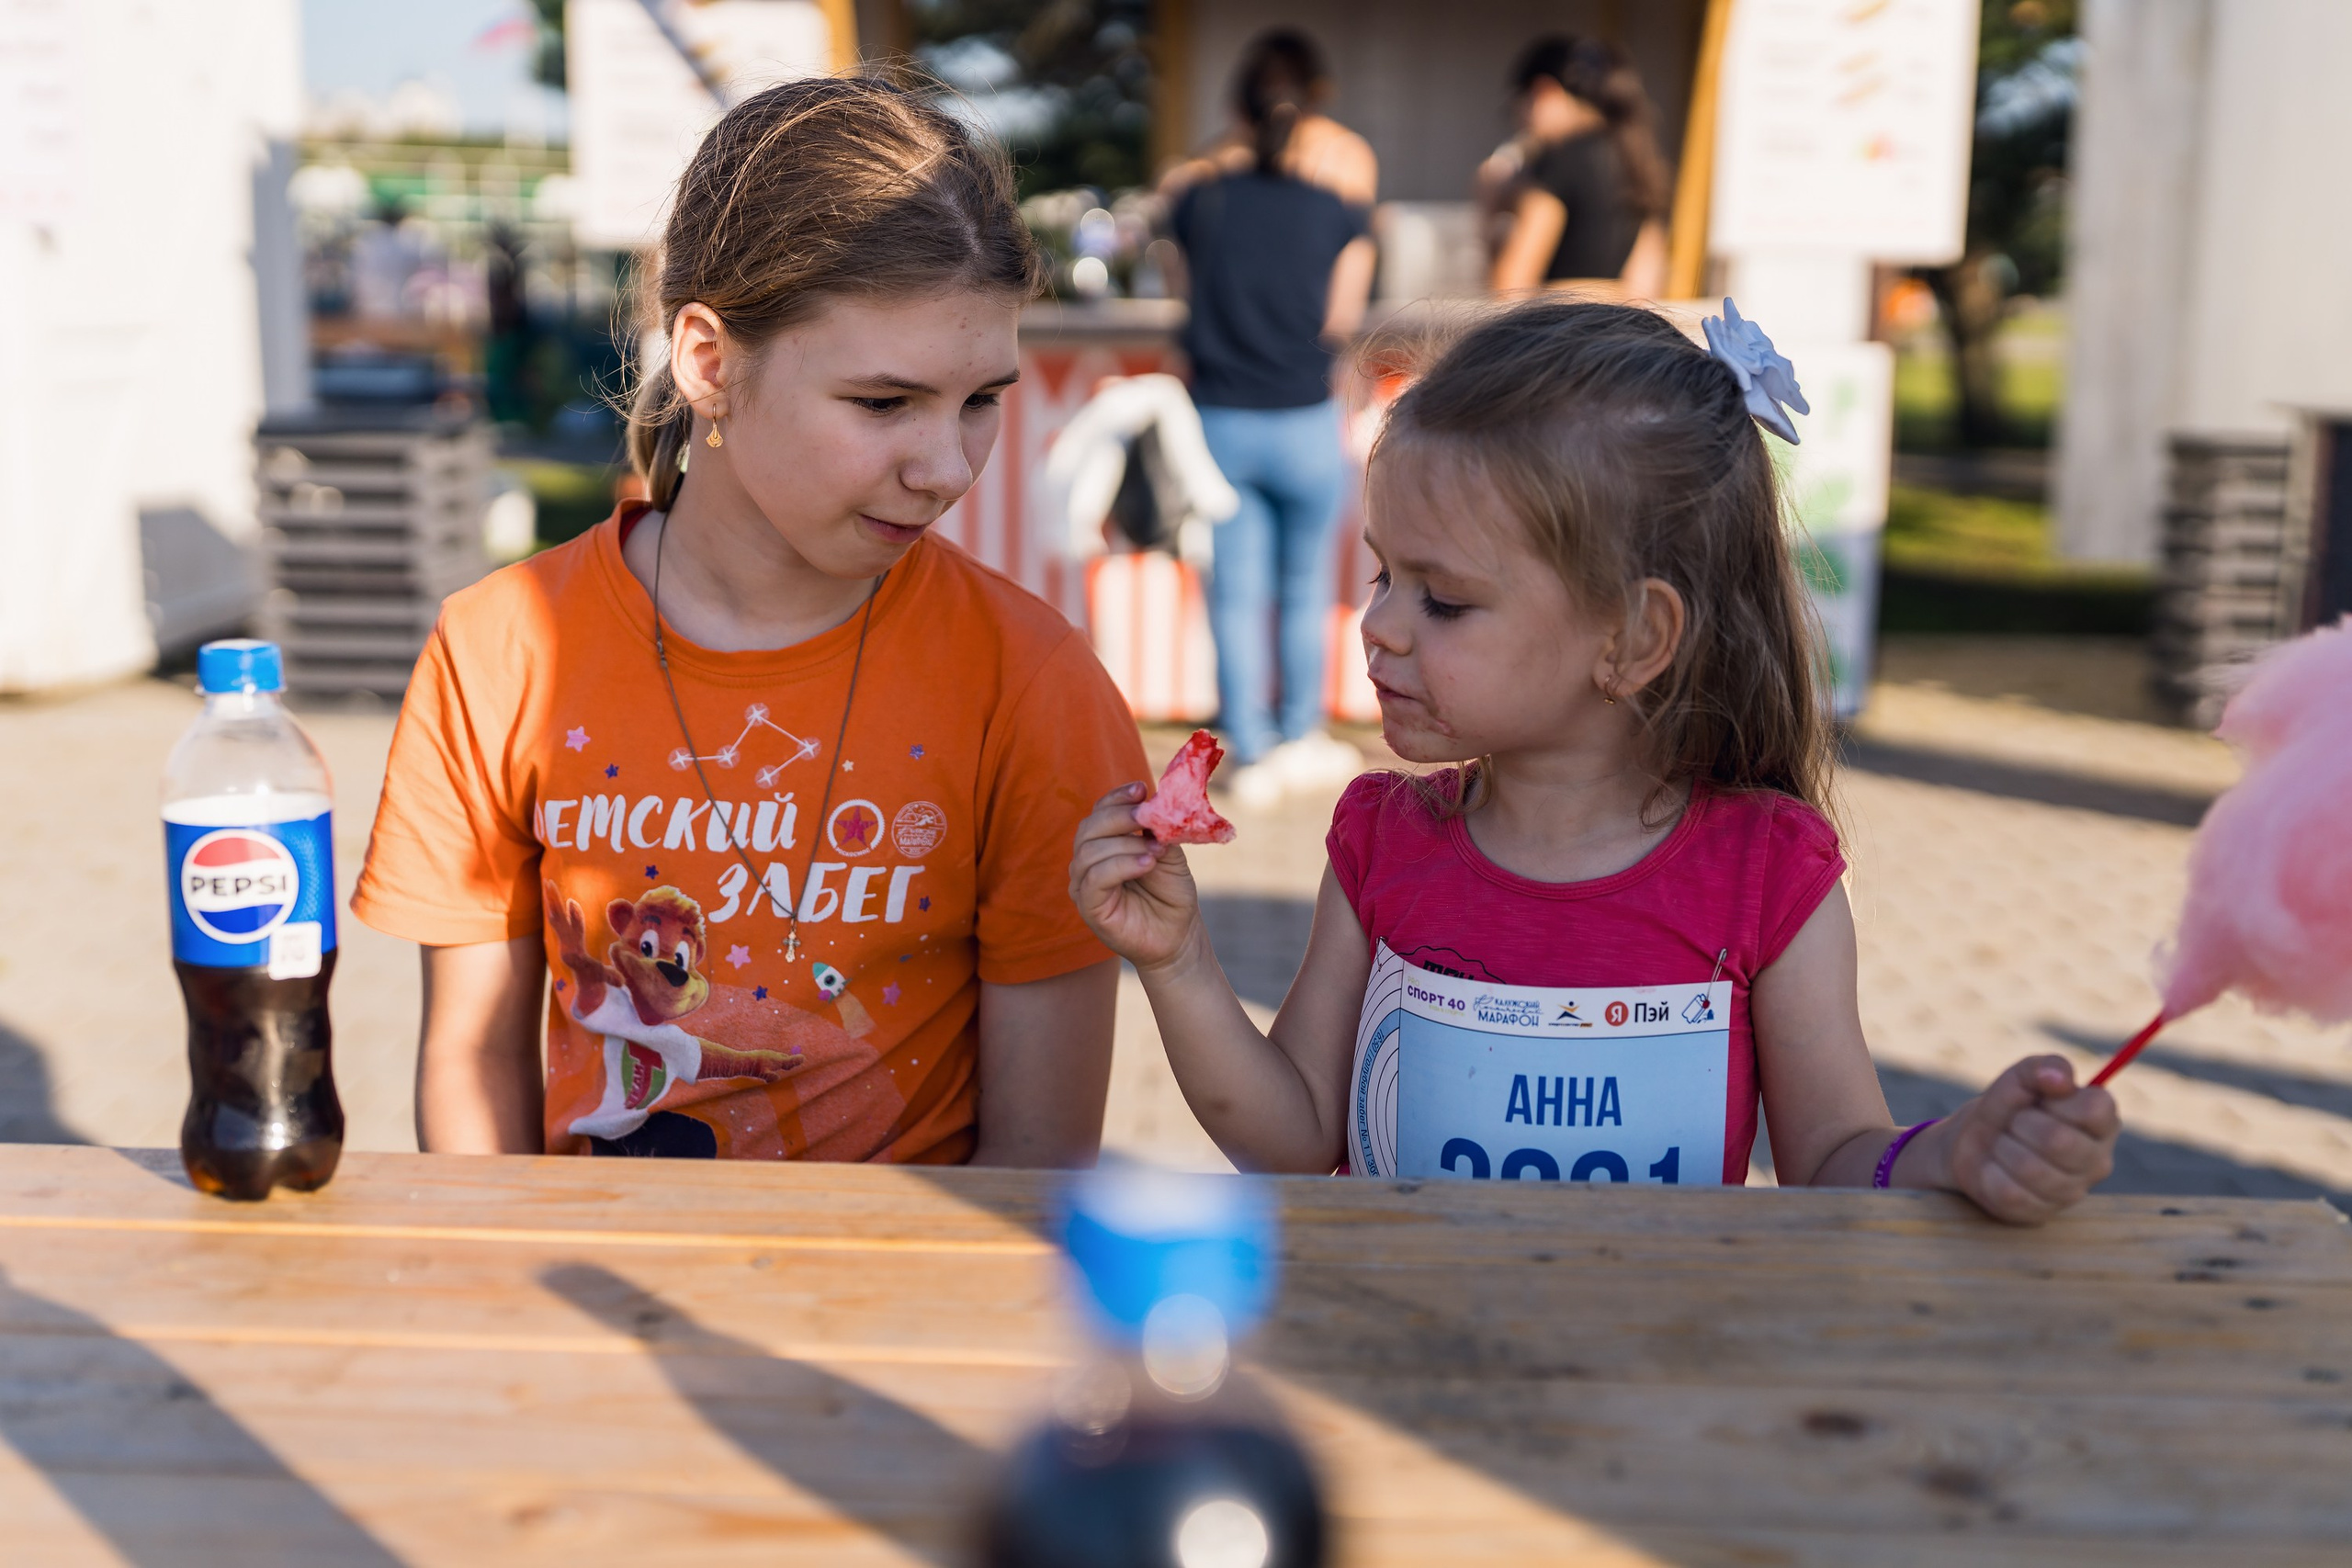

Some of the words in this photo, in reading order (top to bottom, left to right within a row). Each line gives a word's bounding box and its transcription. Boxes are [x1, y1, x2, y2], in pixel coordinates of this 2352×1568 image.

[191, 875, 287, 897] PEPSI
[708, 862, 926, 923] ЗАБЕГ
[1408, 985, 1445, 1007] СПОРТ
[1448, 998, 1465, 1011] 40
[1478, 1010, 1540, 1028] МАРАФОН
[1634, 1001, 1670, 1023] Пэй
[1360, 1055, 1373, 1094] голубой
[1505, 1074, 1623, 1127] АННА
